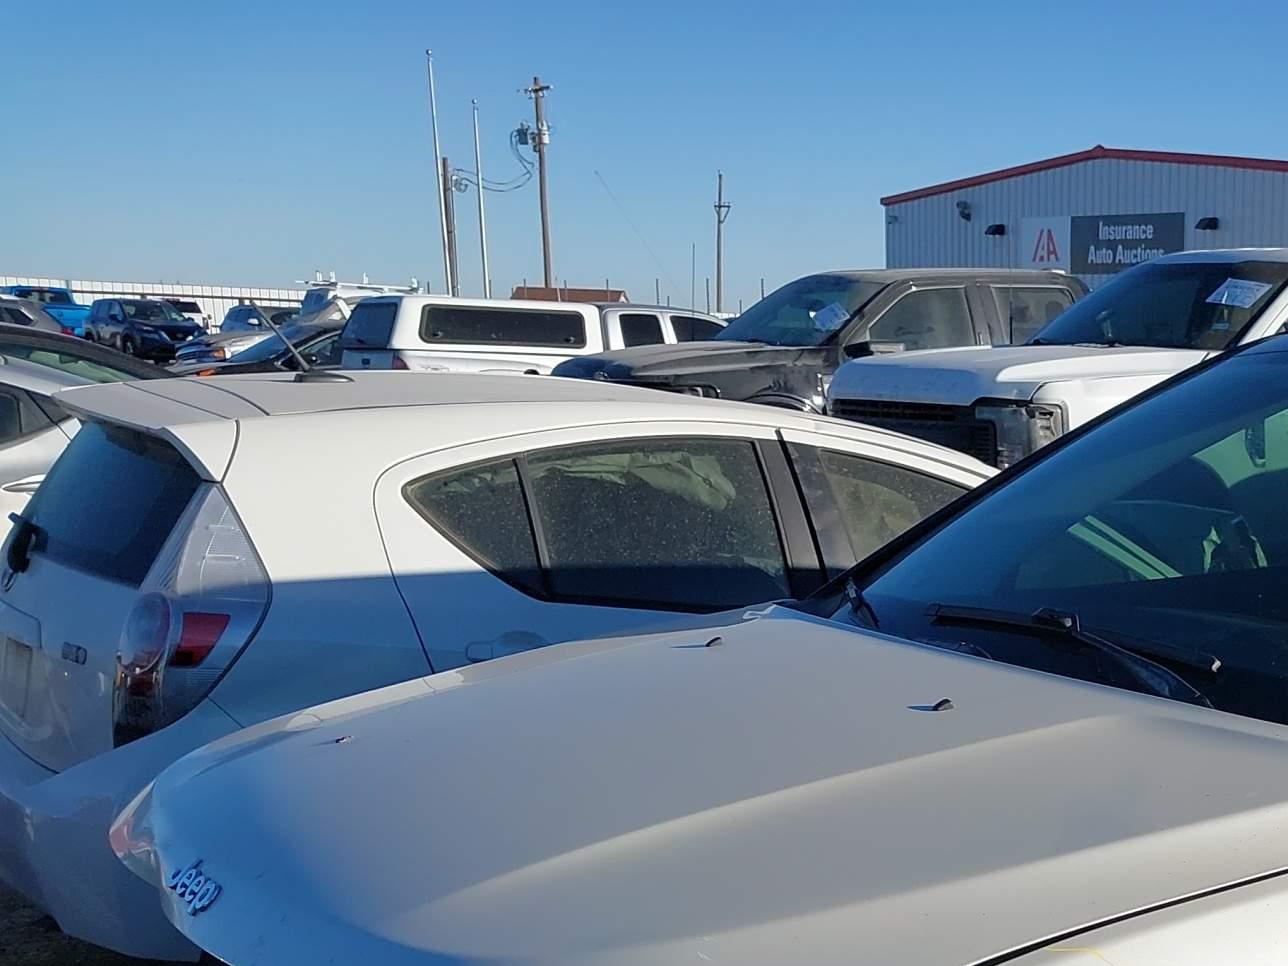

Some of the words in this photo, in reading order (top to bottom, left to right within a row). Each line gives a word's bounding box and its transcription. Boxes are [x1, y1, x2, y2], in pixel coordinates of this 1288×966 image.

[1098, 221, 1154, 241] Insurance
[1087, 244, 1113, 265] Auto
[169, 857, 223, 916] Jeep
